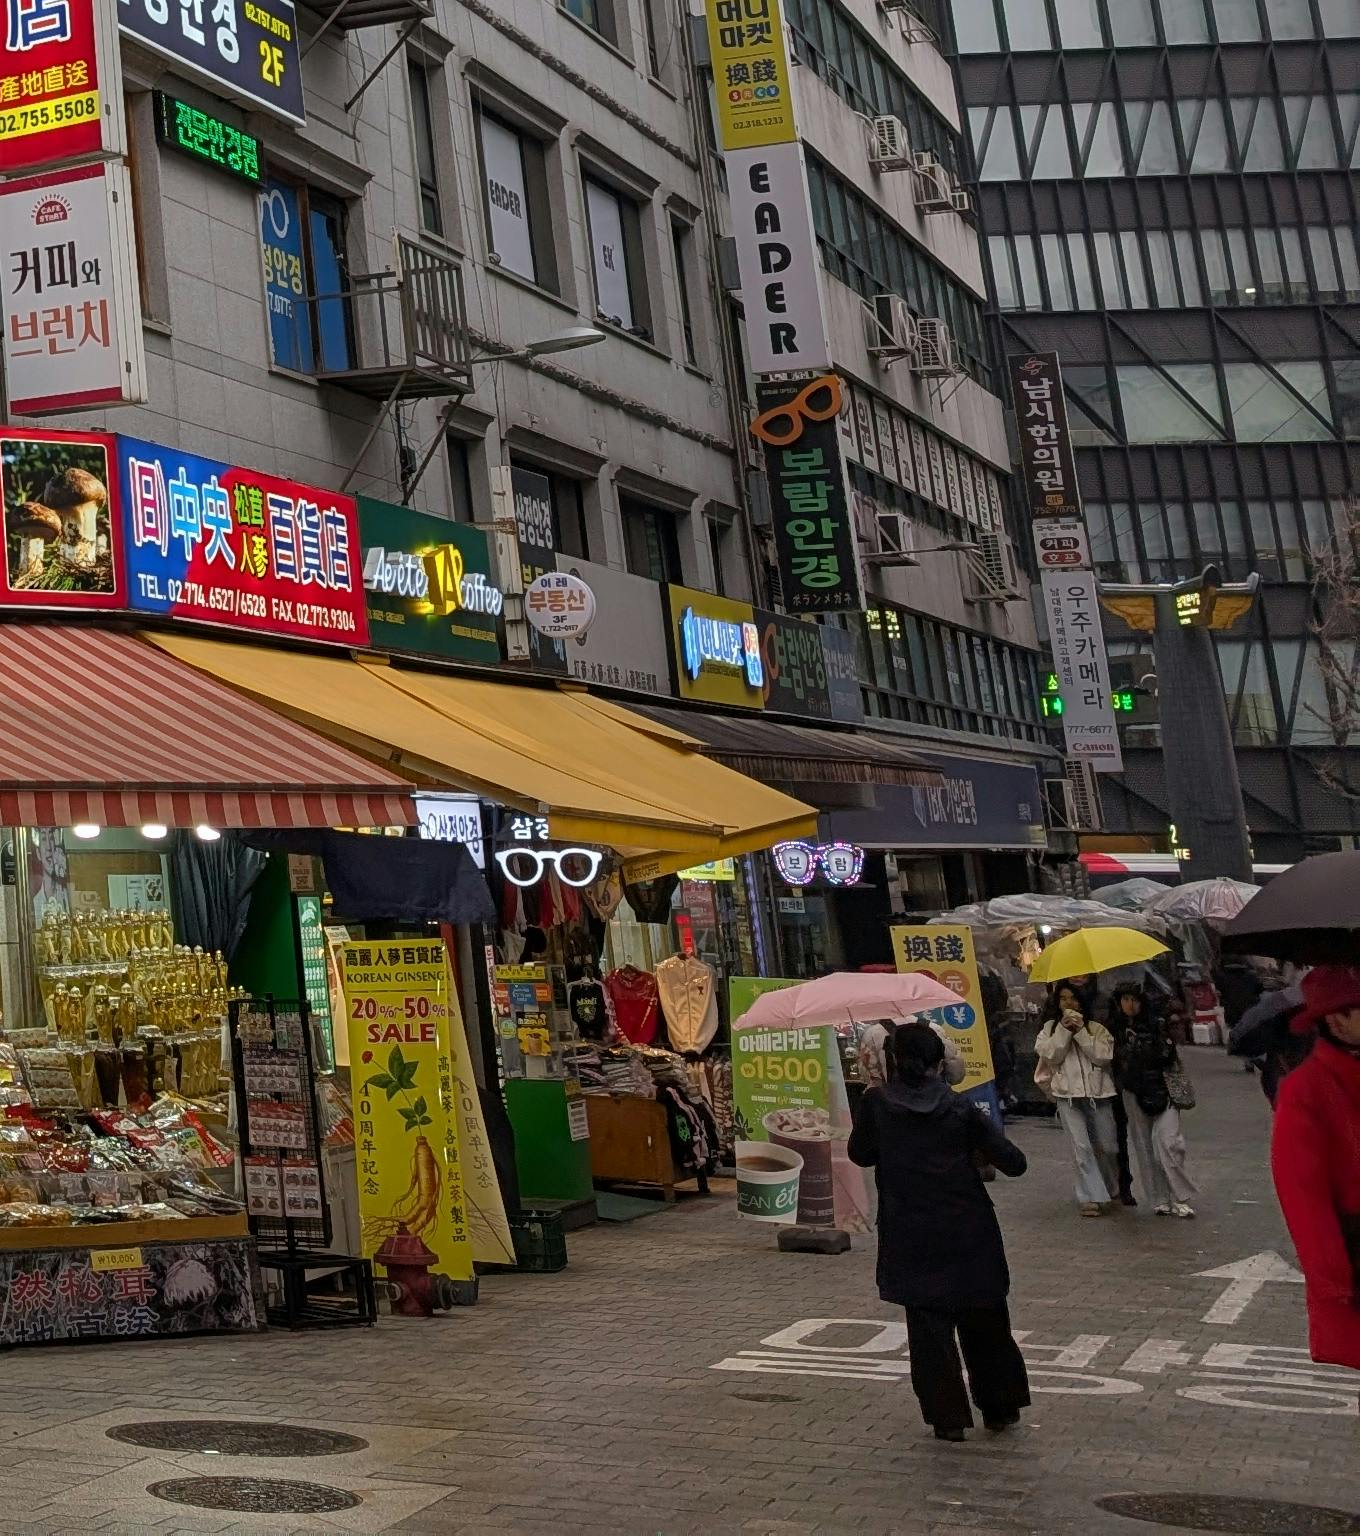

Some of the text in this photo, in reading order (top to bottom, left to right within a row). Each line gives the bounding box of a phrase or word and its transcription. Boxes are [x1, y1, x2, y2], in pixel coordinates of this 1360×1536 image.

[719, 21, 773, 49] 마켓
[259, 40, 285, 87] 2F
[40, 204, 62, 215] CAFE
[10, 240, 102, 296] 커피와
[747, 163, 800, 356] EADER
[10, 299, 111, 357] 브런치
[1019, 376, 1066, 492] 남시한의원
[780, 447, 841, 588] 보람안경
[266, 491, 353, 593] 百貨店
[138, 572, 167, 602] TEL.
[167, 580, 267, 618] 02.774.6527/6528
[271, 596, 296, 622] FAX.
[296, 602, 356, 632] 02.773.9304
[529, 590, 586, 613] 부동산
[552, 615, 568, 624] 3F
[1066, 585, 1105, 711] 우주카메라
[1067, 724, 1113, 735] 777-6677
[1071, 740, 1115, 753] Canon
[346, 970, 445, 984] KOREAN GINSENG
[367, 1022, 437, 1044] SALE
